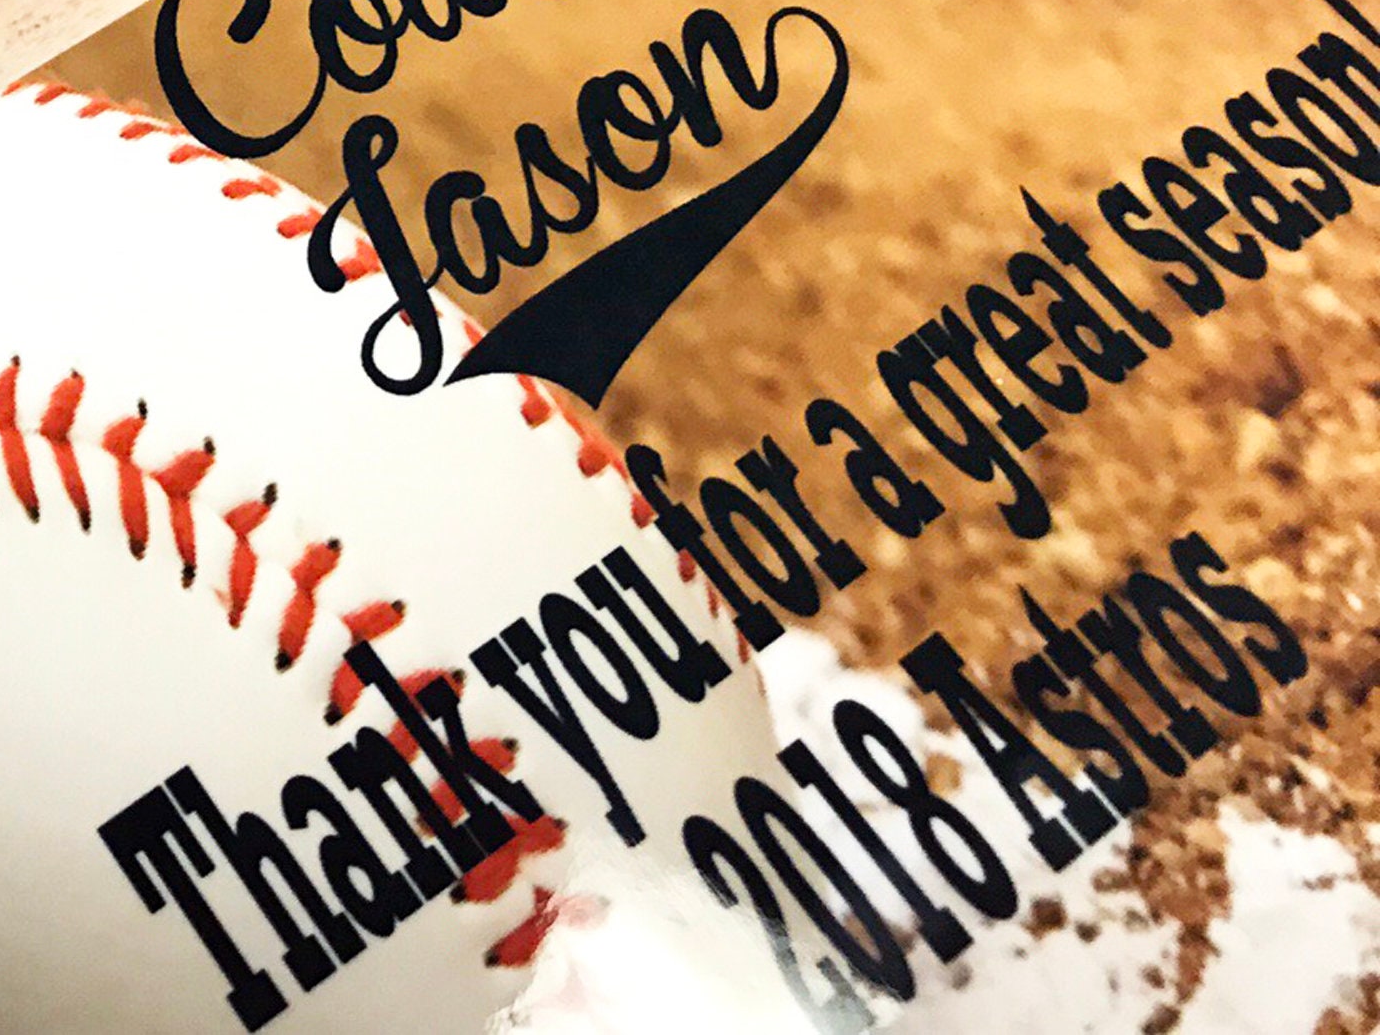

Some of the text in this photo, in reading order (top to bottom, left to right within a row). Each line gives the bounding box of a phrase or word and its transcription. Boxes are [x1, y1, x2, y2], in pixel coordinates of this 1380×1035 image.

[308, 8, 850, 396] Jason
[97, 640, 546, 1034] Thank
[468, 545, 734, 849] you
[625, 443, 868, 652] for
[804, 397, 946, 539] a
[875, 185, 1173, 540] great
[682, 532, 1310, 1035] 2018 Astros
